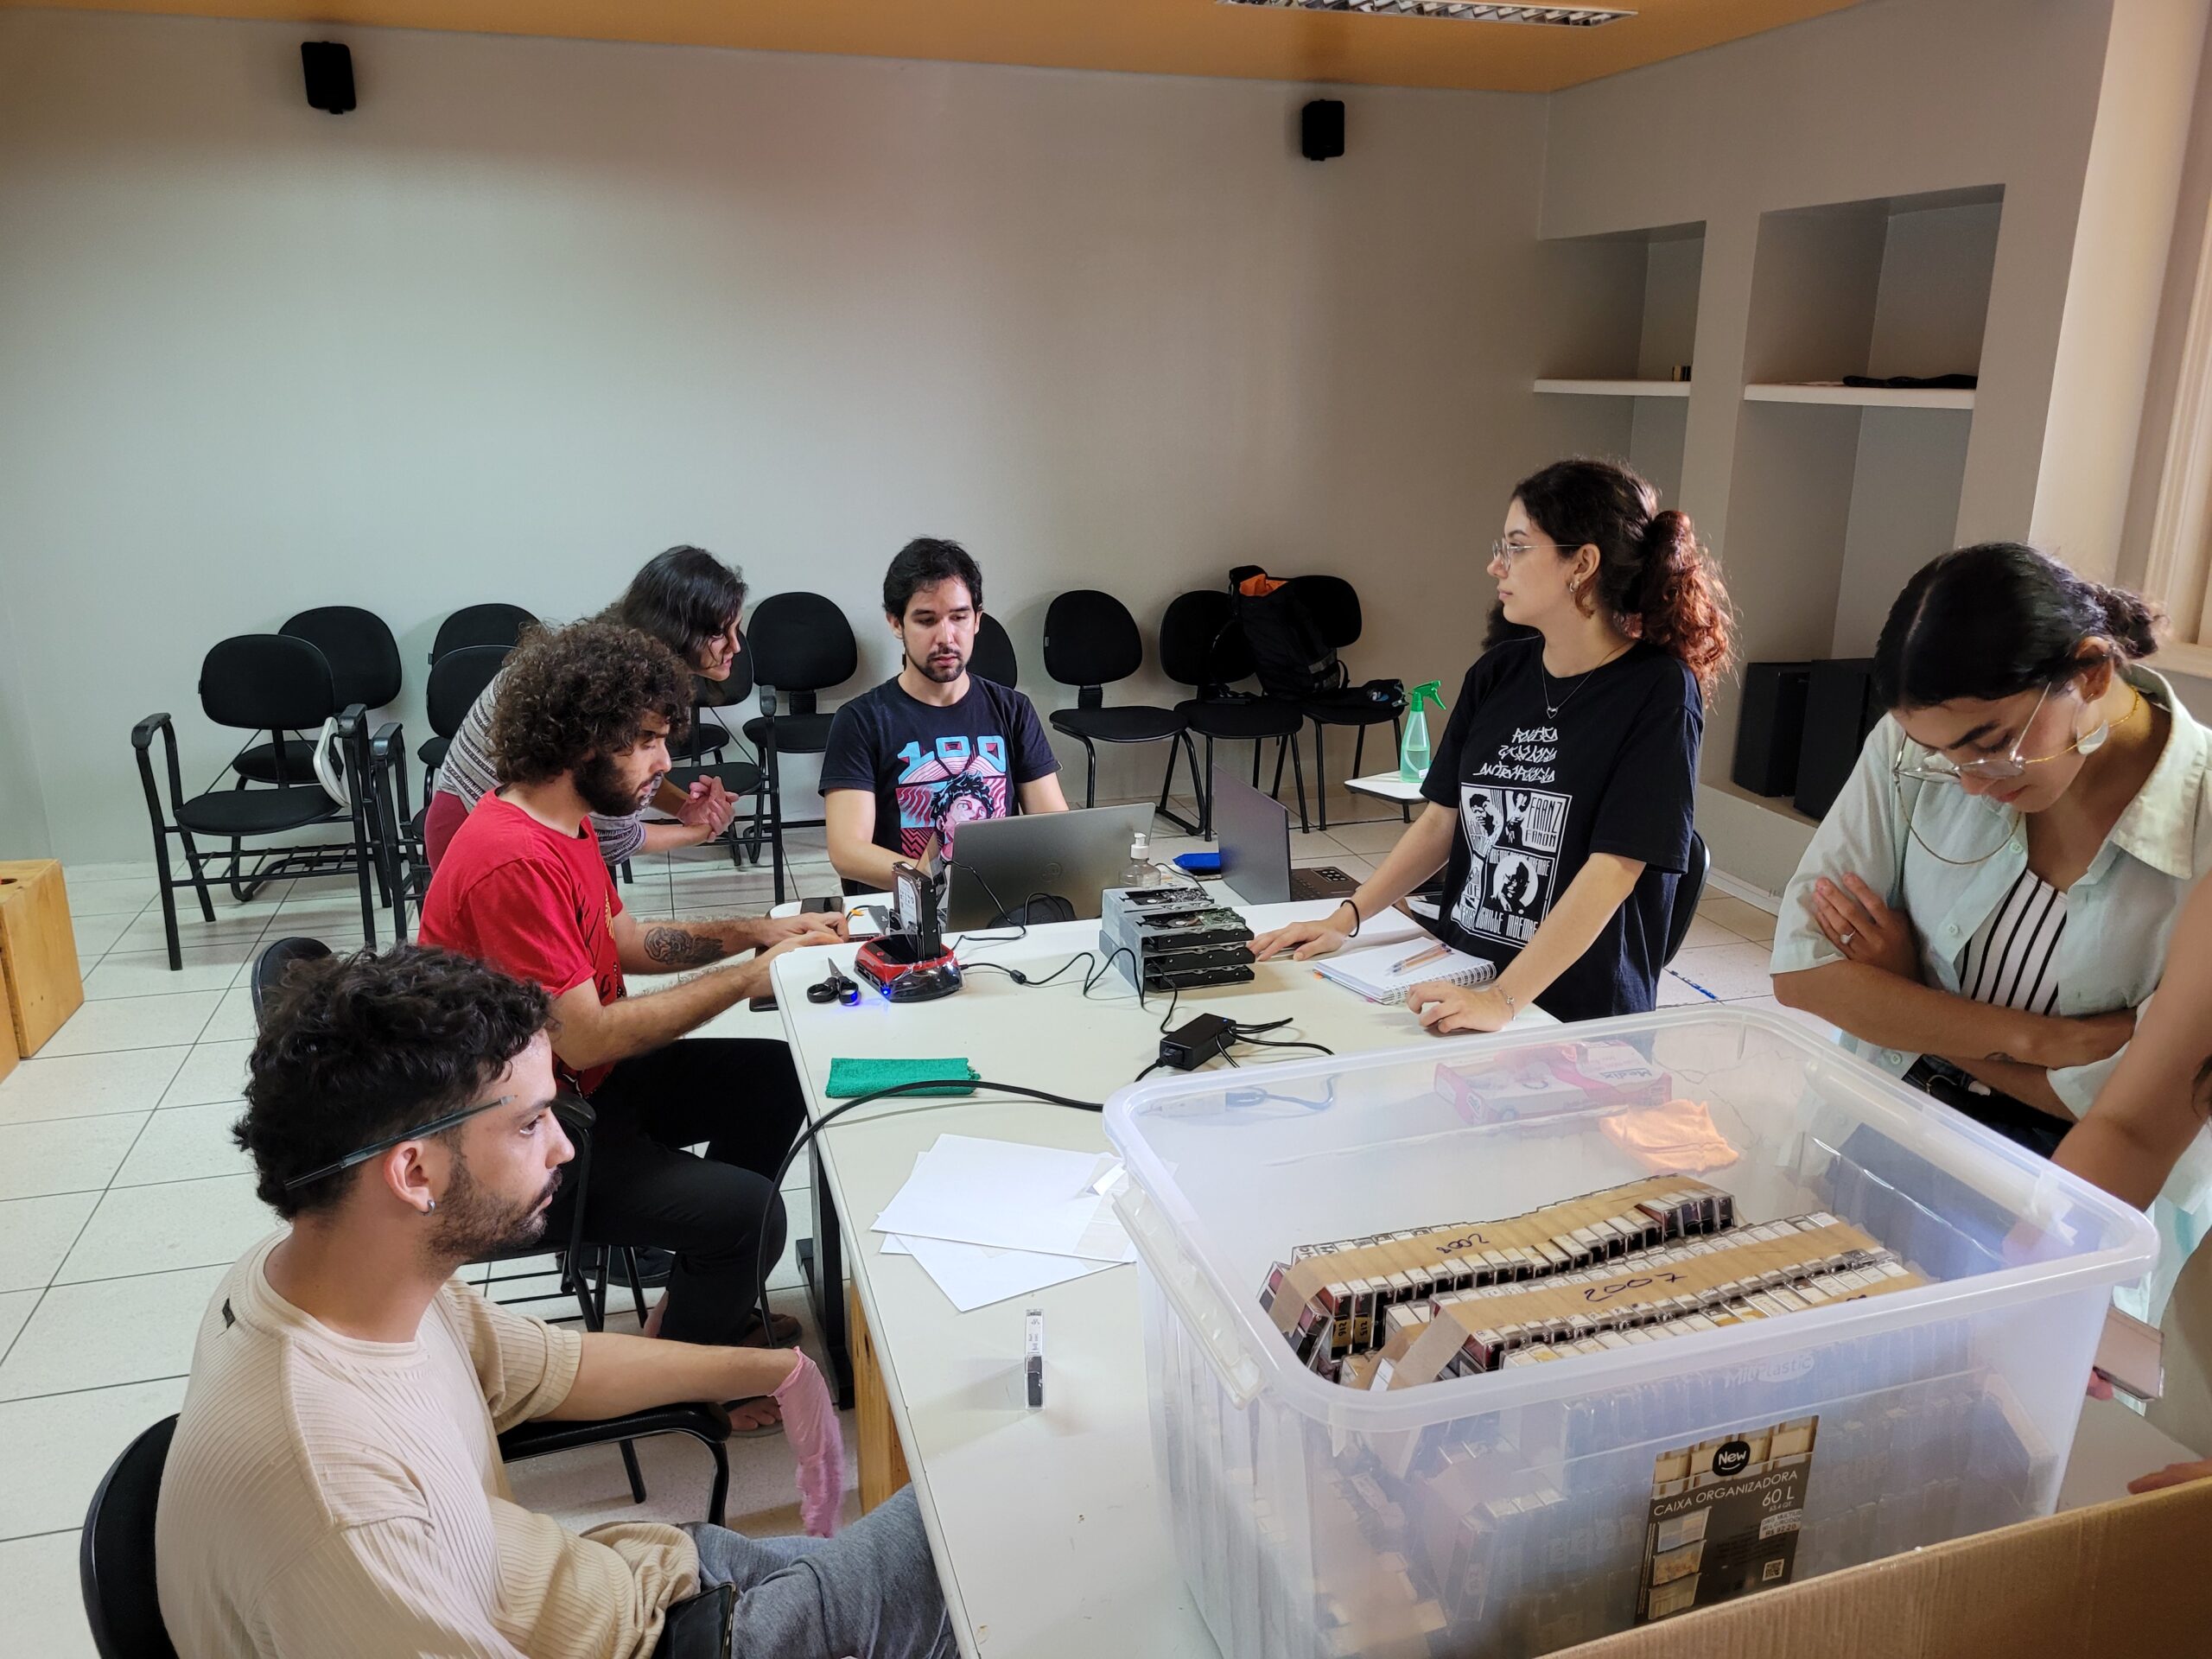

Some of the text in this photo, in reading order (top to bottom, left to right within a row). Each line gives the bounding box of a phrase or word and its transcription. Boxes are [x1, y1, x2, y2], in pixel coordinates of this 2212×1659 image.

[1526, 797, 1563, 834] FRANZ
[1525, 829, 1556, 847] FANON
[1584, 1272, 1688, 1302] 2007
[1718, 1449, 1747, 1466] New
[1653, 1470, 1798, 1516] CAIXA ORGANIZADORA
[1763, 1485, 1795, 1506] 60 L
